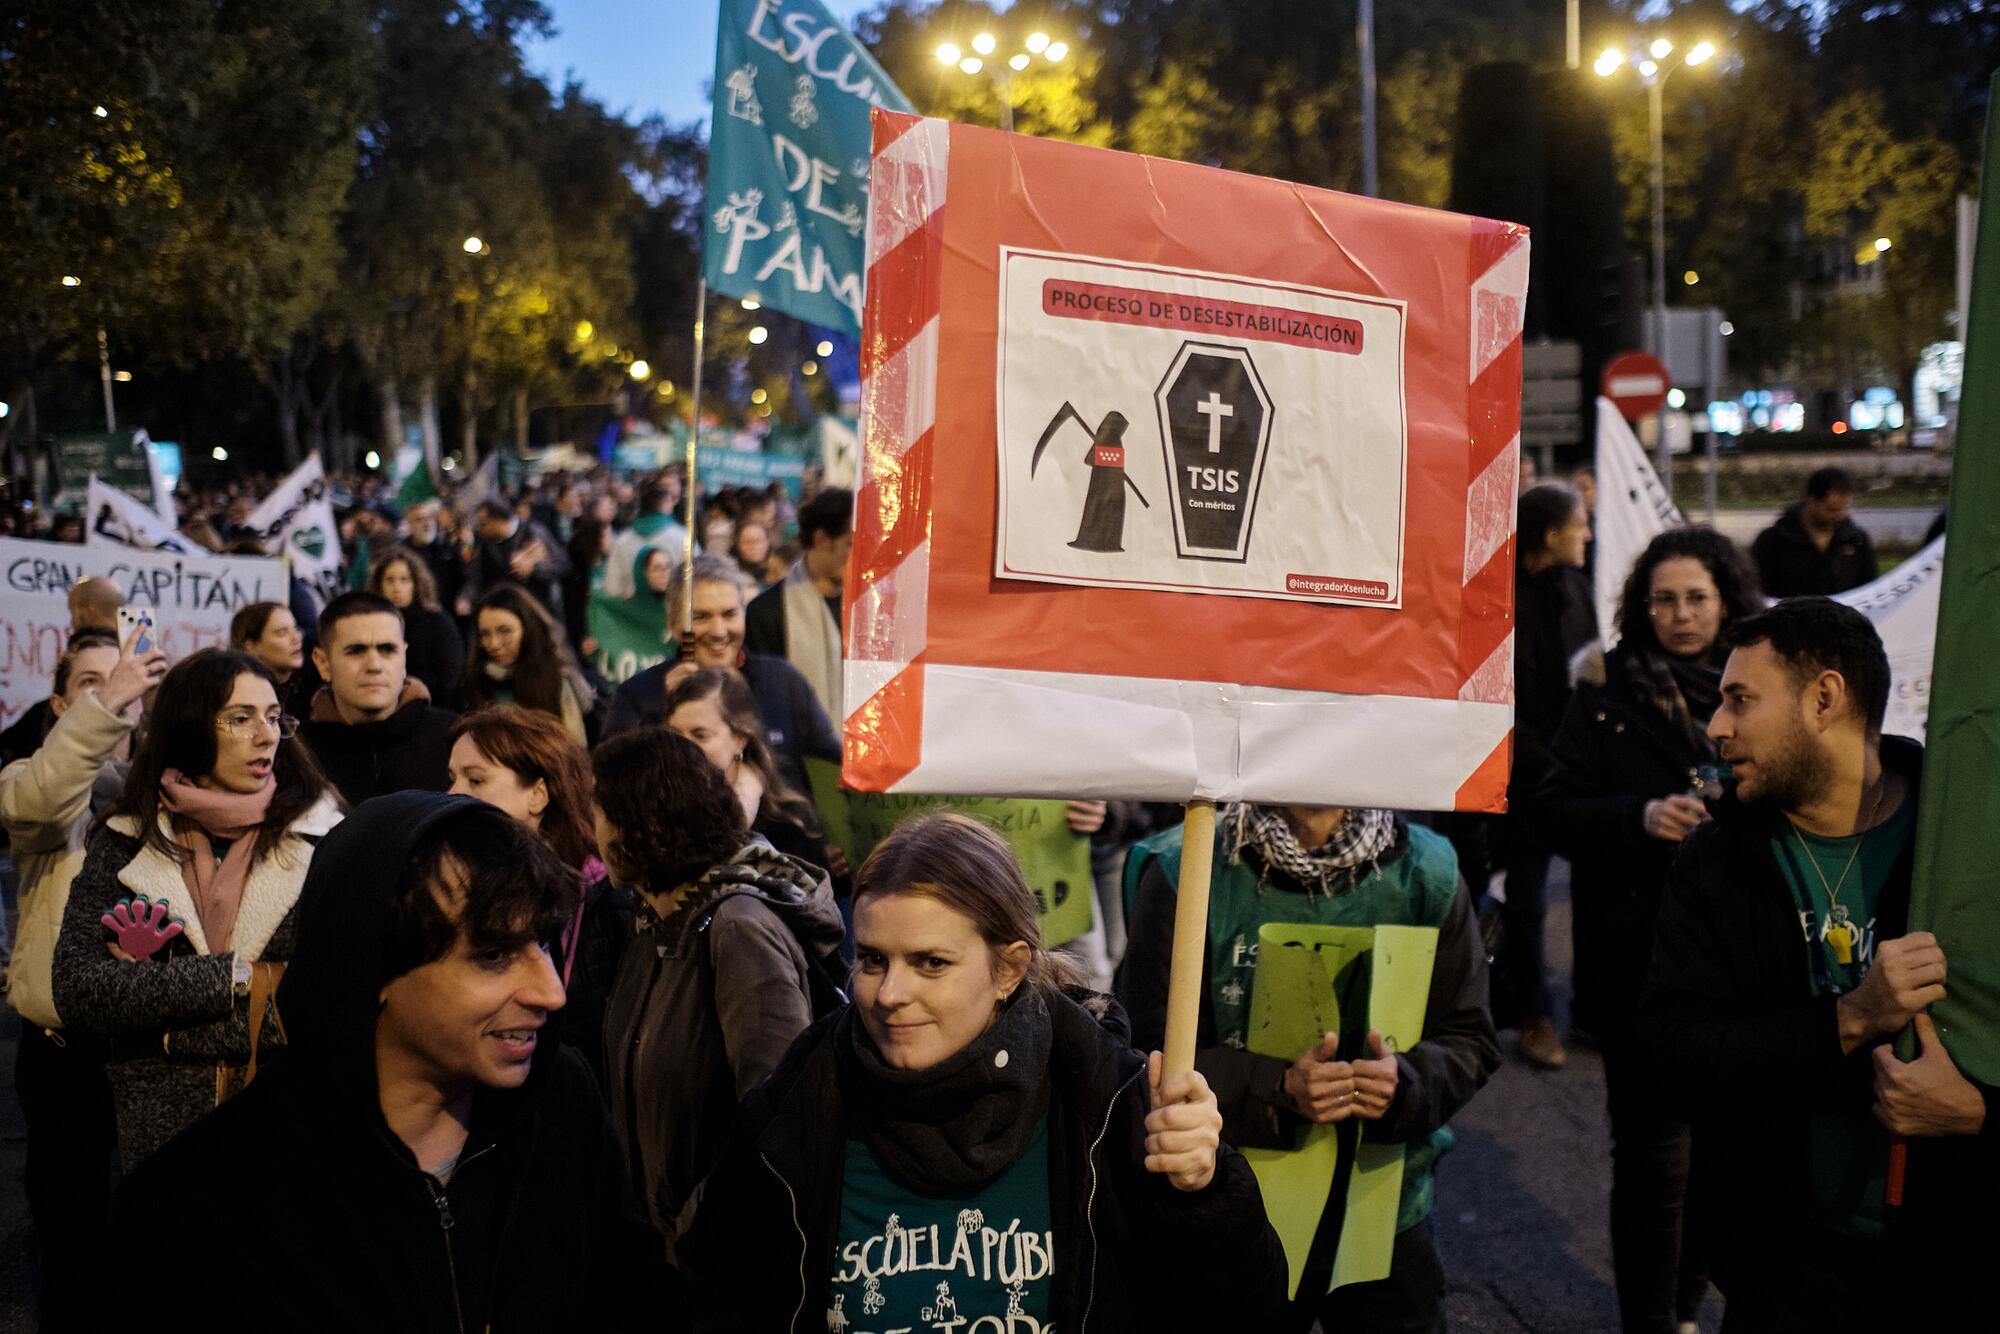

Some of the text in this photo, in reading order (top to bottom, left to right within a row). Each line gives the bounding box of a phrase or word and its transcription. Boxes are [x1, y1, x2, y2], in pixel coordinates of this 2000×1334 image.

[774, 133, 861, 225] DE
[1051, 289, 1357, 346] PROCESO DE DESESTABILIZACIÓN
[1186, 466, 1240, 493] TSIS
[1188, 499, 1236, 511] Con méritos
[1289, 578, 1386, 597] @integradorXsenlucha
[831, 1223, 976, 1283] SCUELA
